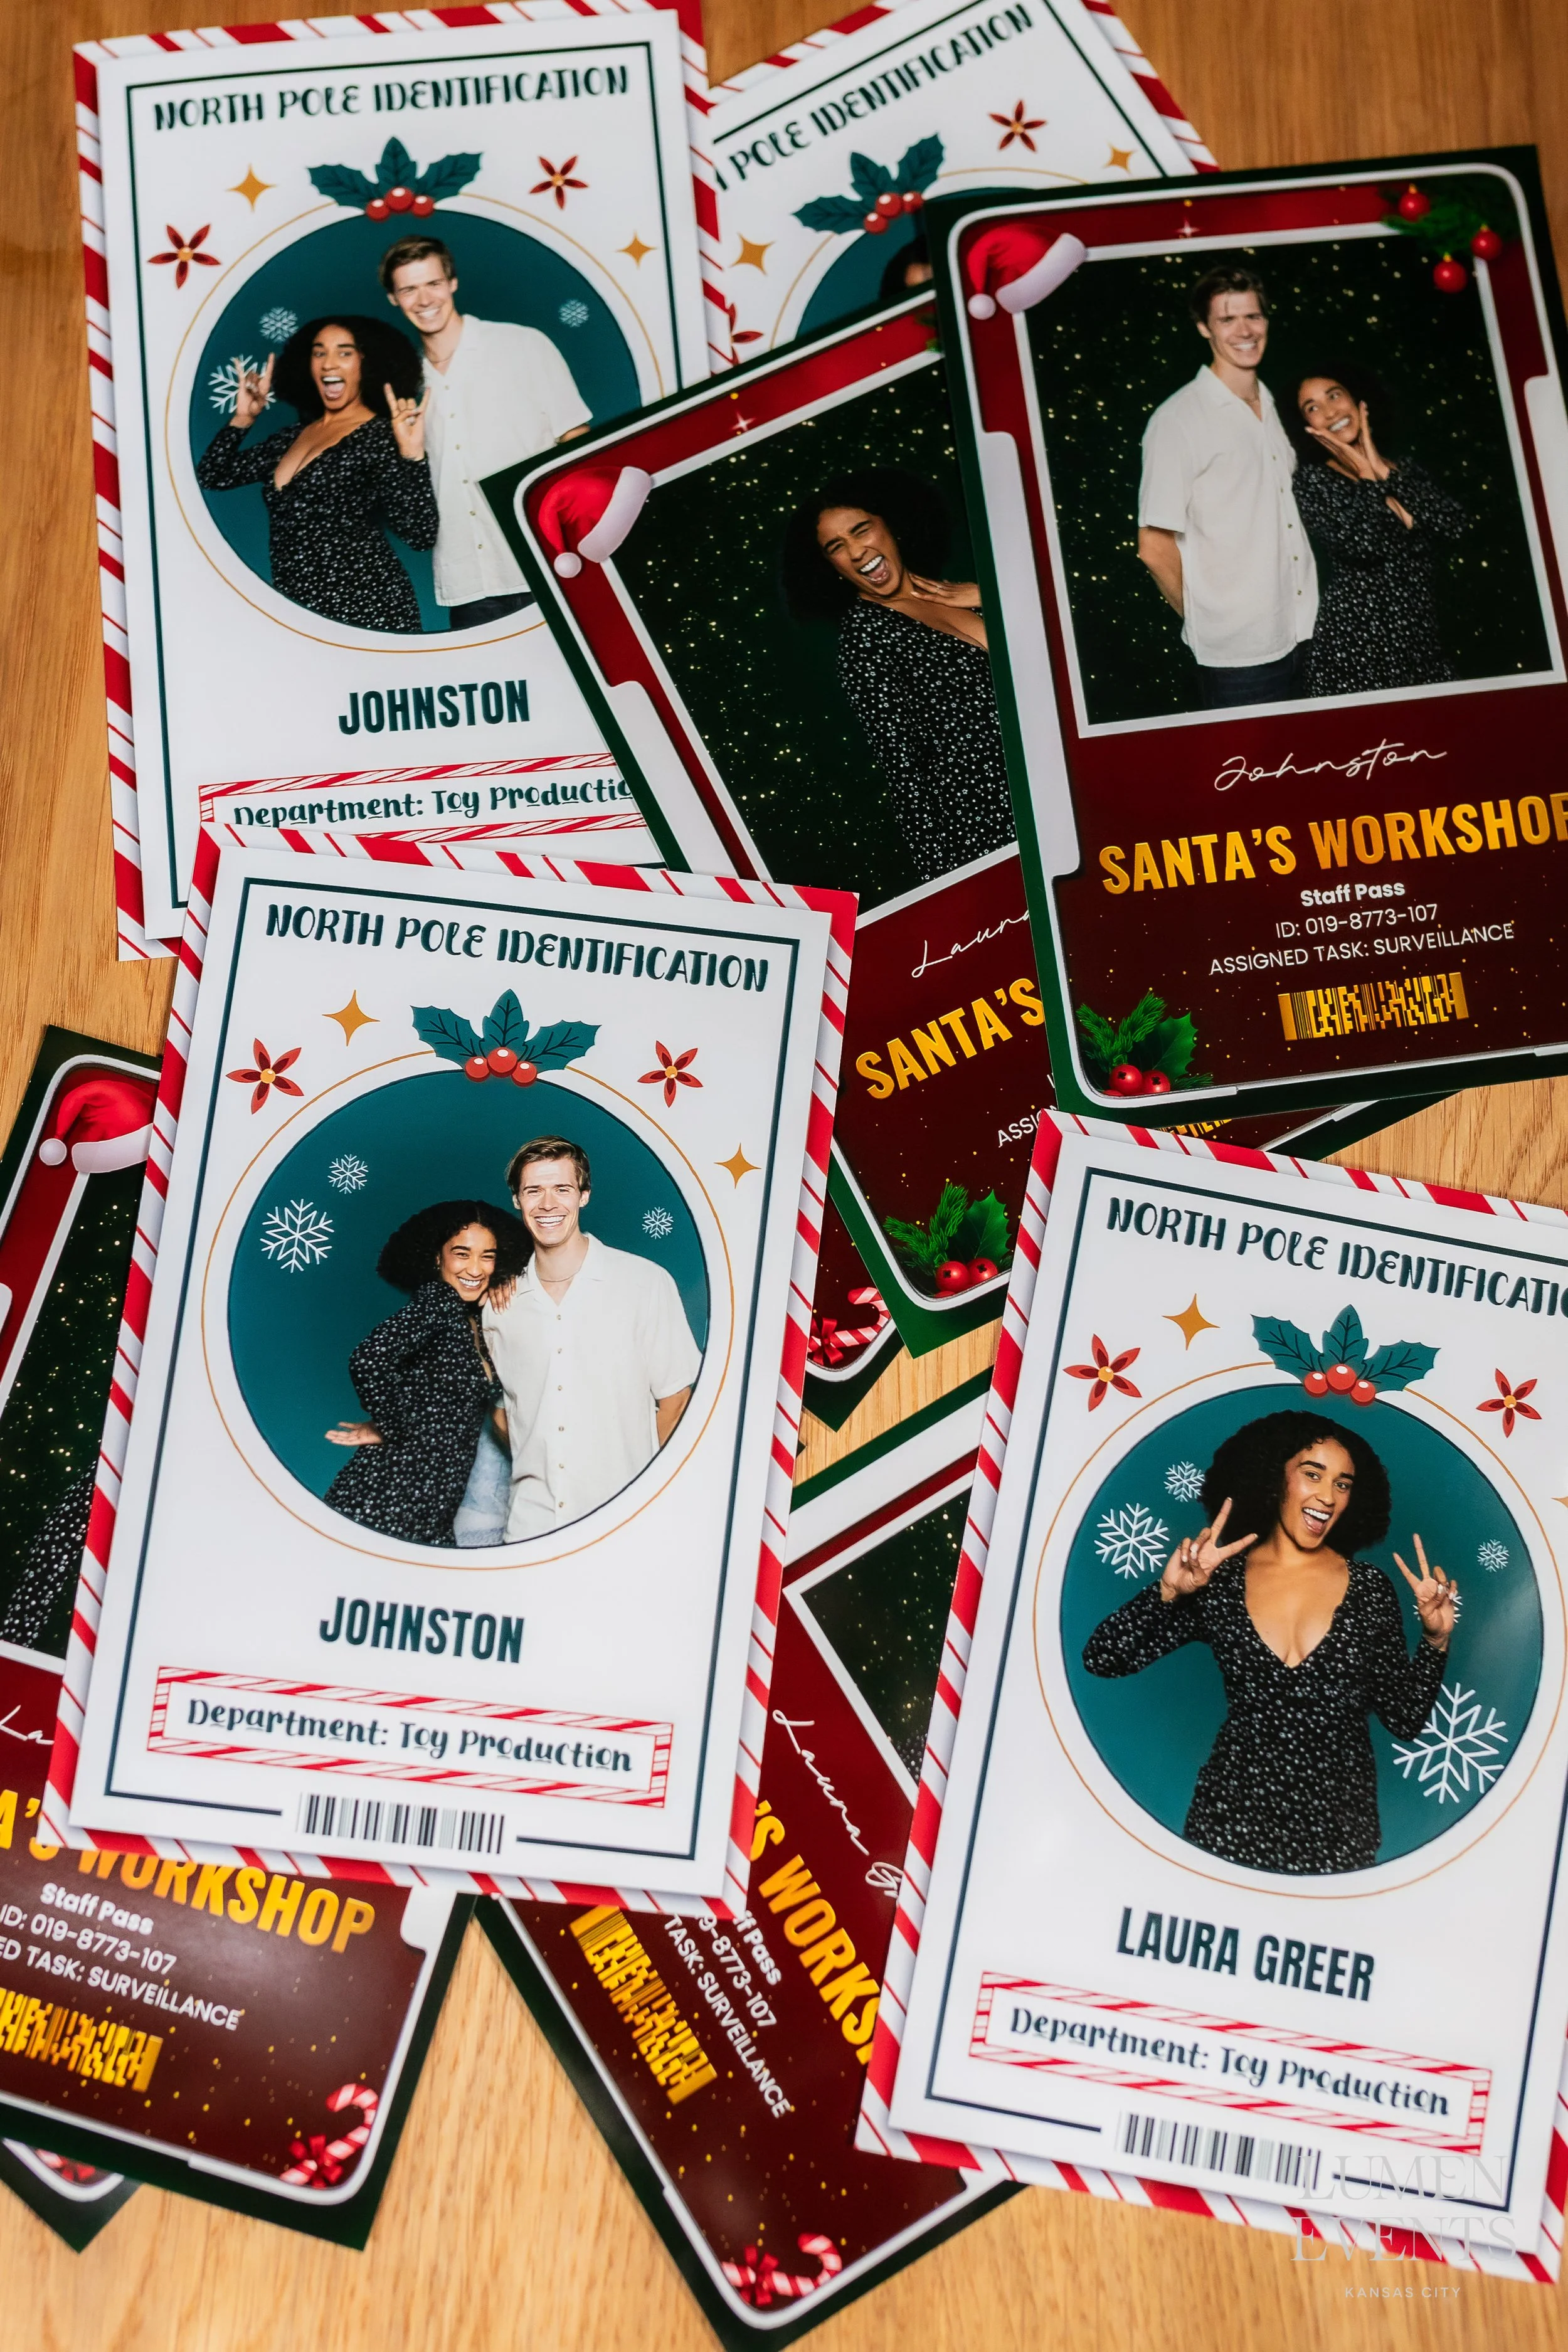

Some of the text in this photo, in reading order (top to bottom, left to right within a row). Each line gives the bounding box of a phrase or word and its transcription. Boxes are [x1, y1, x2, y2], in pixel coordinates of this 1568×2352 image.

[154, 65, 629, 130] NORTH POLE IDENTIFICATION
[729, 3, 1034, 181] POLE IDENTIFICATION
[339, 679, 531, 735] JOHNSTON
[1213, 738, 1448, 792] Johnston
[233, 793, 424, 829] Department:
[431, 790, 479, 818] Toy
[1098, 825, 1297, 895] SANTA'S
[1300, 881, 1406, 908] Staff Pass
[265, 903, 769, 993] NORTH POLE IDENTIFICATION
[1209, 922, 1515, 976] ASSIGNED TASK: SURVEILLANCE
[1275, 903, 1438, 939] ID: 019-8773-107
[855, 977, 1045, 1100] SANTA'S
[1106, 1197, 1226, 1252] NORTH
[1236, 1221, 1328, 1271] POLE
[319, 1596, 525, 1664] JOHNSTON
[187, 1697, 632, 1772] Department: Toy Production
[0, 1903, 28, 1931] ID:
[30, 1913, 177, 1975] 019-8773-107
[40, 1882, 154, 1936] Staff Pass
[27, 1945, 86, 1983] TASK:
[87, 1964, 243, 2032] SURVEILLANCE
[694, 1914, 778, 2028] 9-8773-107
[743, 1927, 782, 1986] Pass
[1116, 1906, 1376, 2002] LAURA GREER
[664, 1913, 792, 2119] TASK: SURVEILLANCE
[1010, 2007, 1451, 2116] Department: Toy Production
